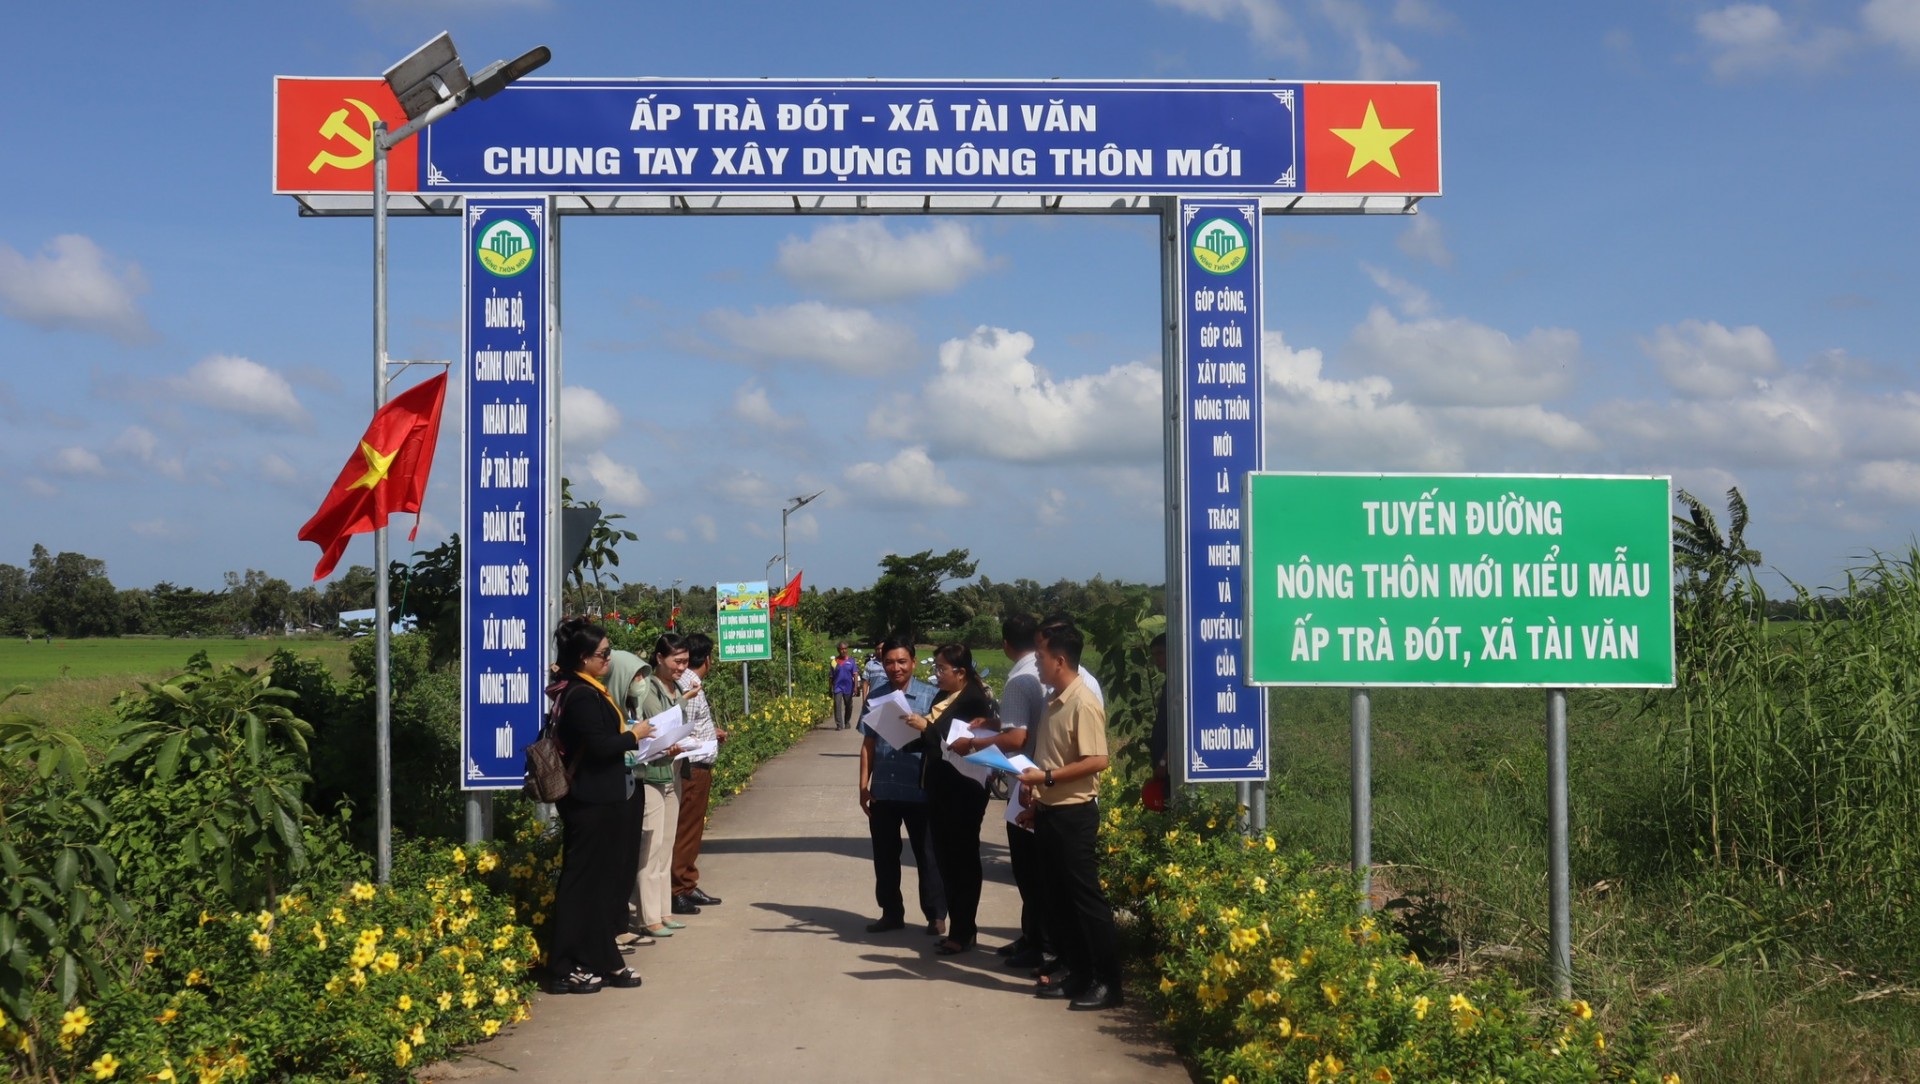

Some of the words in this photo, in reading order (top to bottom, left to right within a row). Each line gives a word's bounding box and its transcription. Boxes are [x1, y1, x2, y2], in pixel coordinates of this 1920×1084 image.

[630, 94, 681, 131] ẤP
[693, 98, 766, 131] TRÀ
[776, 93, 850, 131] ĐÓT
[887, 99, 940, 131] XÃ
[950, 99, 1008, 131] TÀI
[1020, 99, 1097, 132] VĂN
[484, 146, 621, 175] CHUNG
[633, 147, 699, 175] TAY
[711, 141, 790, 175] XÂY
[803, 145, 911, 182] DỰNG
[925, 142, 1036, 176] NÔNG
[1049, 143, 1153, 177] THÔN
[1166, 144, 1241, 177] MỚI
[485, 287, 509, 328] ĐẢNG
[511, 291, 526, 335] BỘ,
[1194, 286, 1215, 312] GÓP
[1216, 285, 1247, 314] CÔNG,
[1200, 322, 1221, 348] GÓP
[1222, 319, 1243, 348] CỦA
[475, 344, 502, 382] CHÍNH
[504, 340, 535, 385] QUYỀN,
[1197, 359, 1217, 384] XÂY
[1219, 360, 1246, 389] DỰNG
[482, 397, 507, 435] NHÂN
[508, 397, 527, 435] DÂN
[1194, 394, 1223, 421] NÔNG
[1224, 394, 1250, 421] THÔN
[1213, 431, 1233, 457] MỚI
[480, 446, 493, 488] ẤP
[494, 451, 511, 488] TRÀ
[512, 451, 530, 488] ĐÓT
[1217, 467, 1230, 493] LÀ
[482, 504, 507, 542] ĐOÀN
[508, 501, 526, 546] KẾT,
[1208, 504, 1240, 530] TRÁCH
[1362, 487, 1457, 536] TUYẾN
[1465, 491, 1563, 536] ĐƯỜNG
[1208, 540, 1241, 571] NHIỆM
[1277, 555, 1354, 599] NÔNG
[1361, 554, 1439, 599] THÔN
[1449, 554, 1503, 598] MỚI
[1512, 544, 1578, 598] KIỂU
[1589, 546, 1650, 597] MẪU
[480, 564, 510, 596] CHUNG
[511, 558, 529, 596] SỨC
[1218, 577, 1232, 603] VÀ
[482, 612, 501, 650] XÂY
[502, 615, 526, 657] DỰNG
[1200, 611, 1233, 642] QUYỀN
[1291, 613, 1330, 661] ẤP
[1337, 617, 1394, 661] TRÀ
[1404, 616, 1471, 668] ĐÓT,
[1480, 617, 1517, 660] XÃ
[1526, 616, 1572, 660] TÀI
[1581, 618, 1639, 659] VĂN
[1216, 648, 1237, 677] CỦA
[479, 666, 504, 704] NÔNG
[505, 666, 529, 704] THÔN
[1217, 684, 1236, 714] MỖI
[495, 720, 513, 759] MỚI
[1200, 727, 1231, 751] NGƯỜI
[1233, 724, 1254, 750] DÂN
